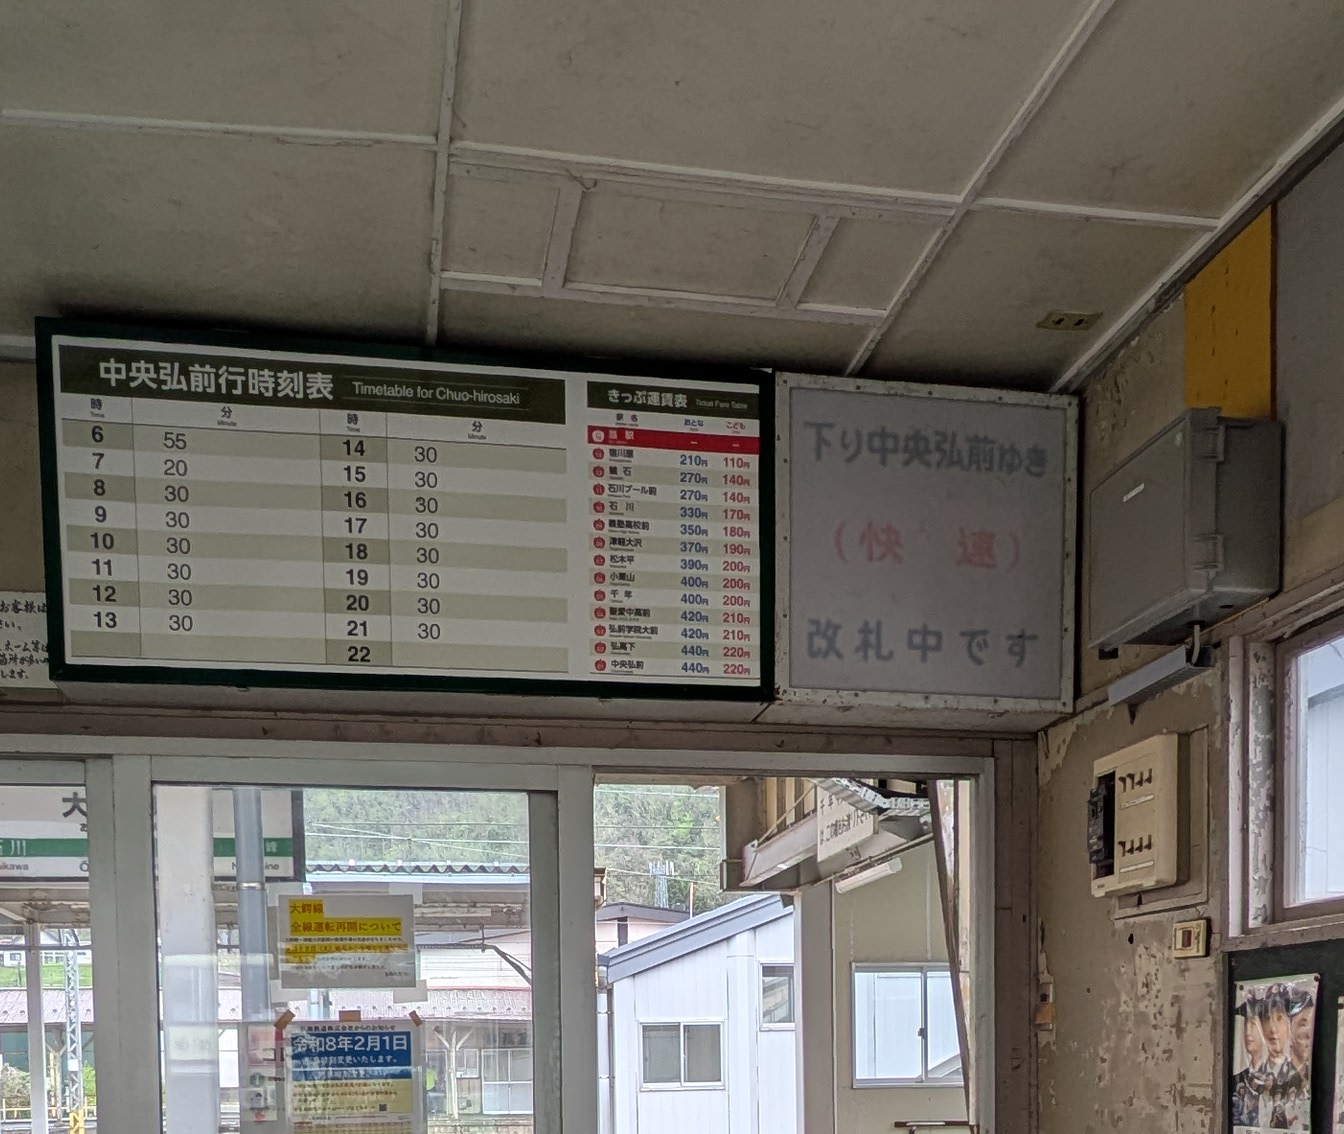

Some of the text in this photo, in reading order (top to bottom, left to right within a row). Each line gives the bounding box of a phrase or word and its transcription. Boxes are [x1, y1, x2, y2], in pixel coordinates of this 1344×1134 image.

[99, 358, 334, 400] 中央弘前行時刻表
[353, 381, 520, 405] Timetable for Chuo-hirosaki
[608, 389, 688, 408] きっぷ運賃表
[91, 398, 483, 432] 時 分 時 分
[684, 419, 704, 427] おとな
[726, 421, 746, 429] こども
[91, 425, 438, 464] 6 55 14 30
[803, 421, 1048, 477] 下り中央弘前ゆき
[92, 452, 438, 489] 7 20 15 30
[680, 454, 708, 467] 210円
[723, 458, 750, 470] 110円
[680, 472, 708, 484] 270円
[723, 474, 750, 487] 140円
[93, 478, 438, 514] 8 30 16 30
[608, 483, 750, 504] 石川プール前 270円 140円
[94, 505, 439, 539] 9 30 17 30
[680, 507, 708, 519] 330円
[723, 509, 750, 521] 170円
[680, 524, 708, 536] 350円
[723, 526, 750, 538] 180円
[90, 532, 440, 564] 10 30 18 30
[609, 537, 750, 556] 津軽大沢 370円 190円
[610, 555, 750, 573] 松木平 390円 200円
[91, 558, 440, 590] 11 30 19 30
[680, 576, 708, 588] 400円
[723, 578, 750, 590] 200円
[92, 584, 441, 615] 12 30 20 30
[680, 594, 708, 606] 400円
[723, 595, 750, 607] 200円
[93, 611, 441, 640] 13 30 21 30
[680, 611, 708, 623] 420円
[723, 612, 750, 625] 210円
[680, 628, 708, 640] 420円
[723, 630, 750, 642] 210円
[807, 617, 1039, 668] 改札中です
[347, 645, 371, 663] 22
[680, 645, 708, 657] 440円
[723, 646, 750, 659] 220円
[611, 660, 750, 676] 中央弘前 440円 220円
[290, 903, 324, 914] 大鰐線
[291, 922, 401, 933] 全線運転再開について
[293, 1035, 407, 1052] 令和8年2月1日
